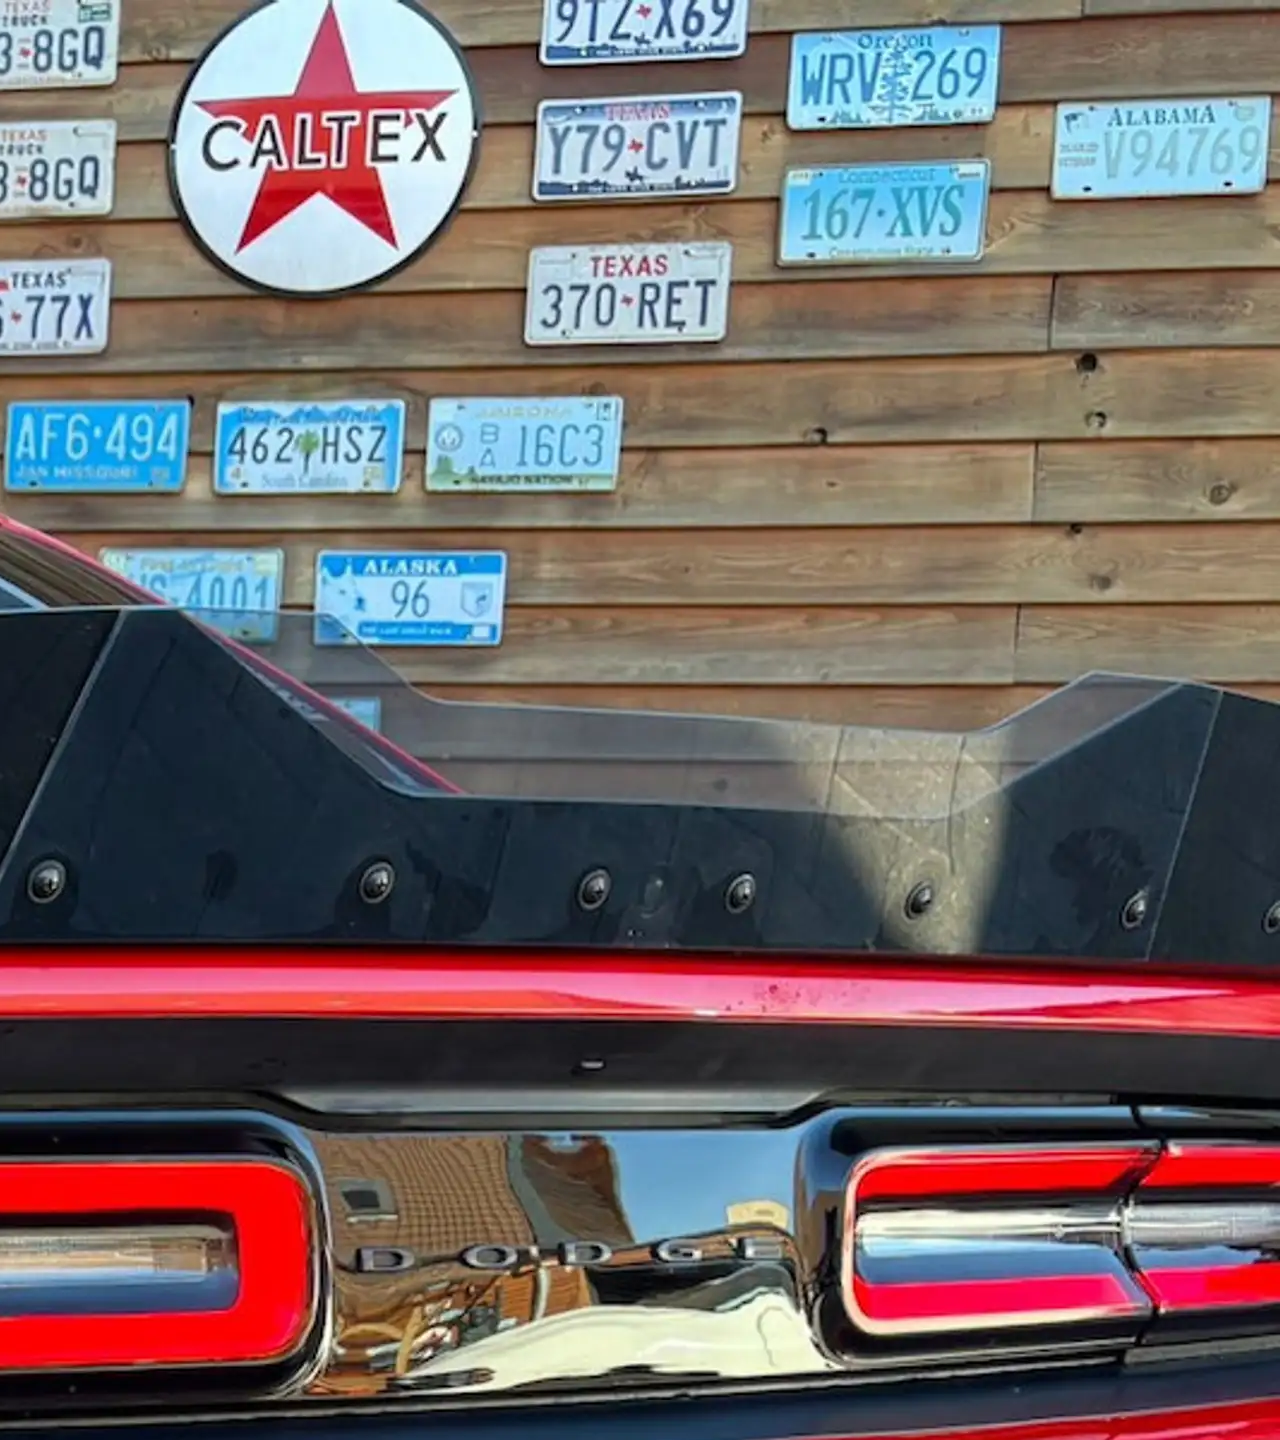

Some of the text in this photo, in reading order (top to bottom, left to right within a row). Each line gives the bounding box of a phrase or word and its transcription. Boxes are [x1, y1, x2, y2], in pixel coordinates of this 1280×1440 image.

[33, 25, 105, 72] 8GQ
[857, 33, 934, 53] Oregon
[801, 47, 987, 106] WRV 269
[1, 129, 48, 142] TEXAS
[1107, 104, 1216, 127] ALABAMA
[201, 112, 449, 171] CALTEX
[548, 118, 727, 175] Y79 CVT
[1104, 125, 1262, 179] V94769
[29, 155, 100, 201] 8GQ
[10, 270, 67, 289] TEXAS
[590, 254, 669, 278] TEXAS
[24, 294, 94, 340] 77X
[541, 279, 717, 330] 370 RET
[227, 425, 388, 465] 462 HSZ
[363, 558, 459, 576] ALASKA
[391, 579, 430, 619] 96
[356, 1237, 783, 1272] DODGE
